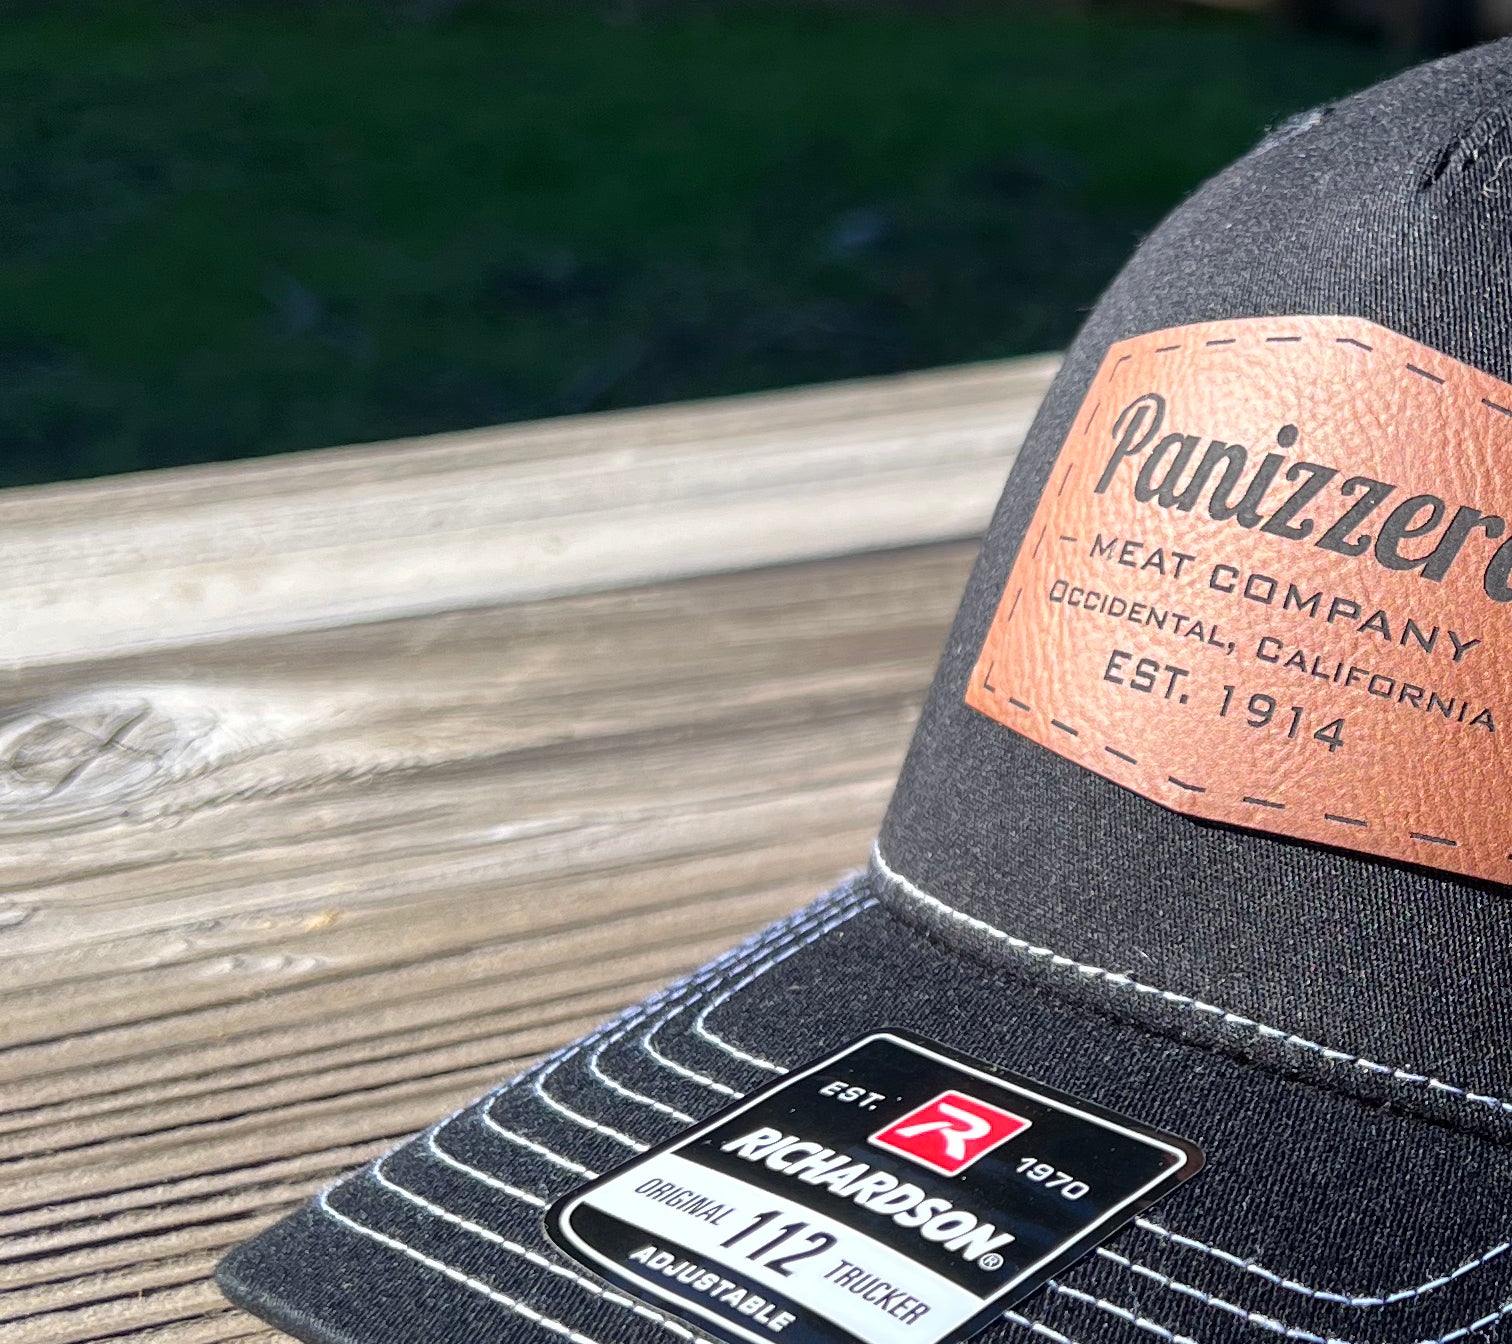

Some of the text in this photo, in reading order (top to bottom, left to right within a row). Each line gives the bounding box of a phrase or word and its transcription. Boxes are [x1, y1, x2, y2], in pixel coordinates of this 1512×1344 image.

[1049, 578, 1496, 732] OCCIDENTAL, CALIFORNIA
[1090, 533, 1481, 663] MEAT COMPANY
[1103, 649, 1346, 753] EST. 1914
[819, 1080, 885, 1110] EST.
[1014, 1156, 1091, 1202] 1970
[629, 1244, 797, 1333] ADJUSTABLE
[634, 1177, 931, 1327] ORIGINAL 112 TRUCKER
